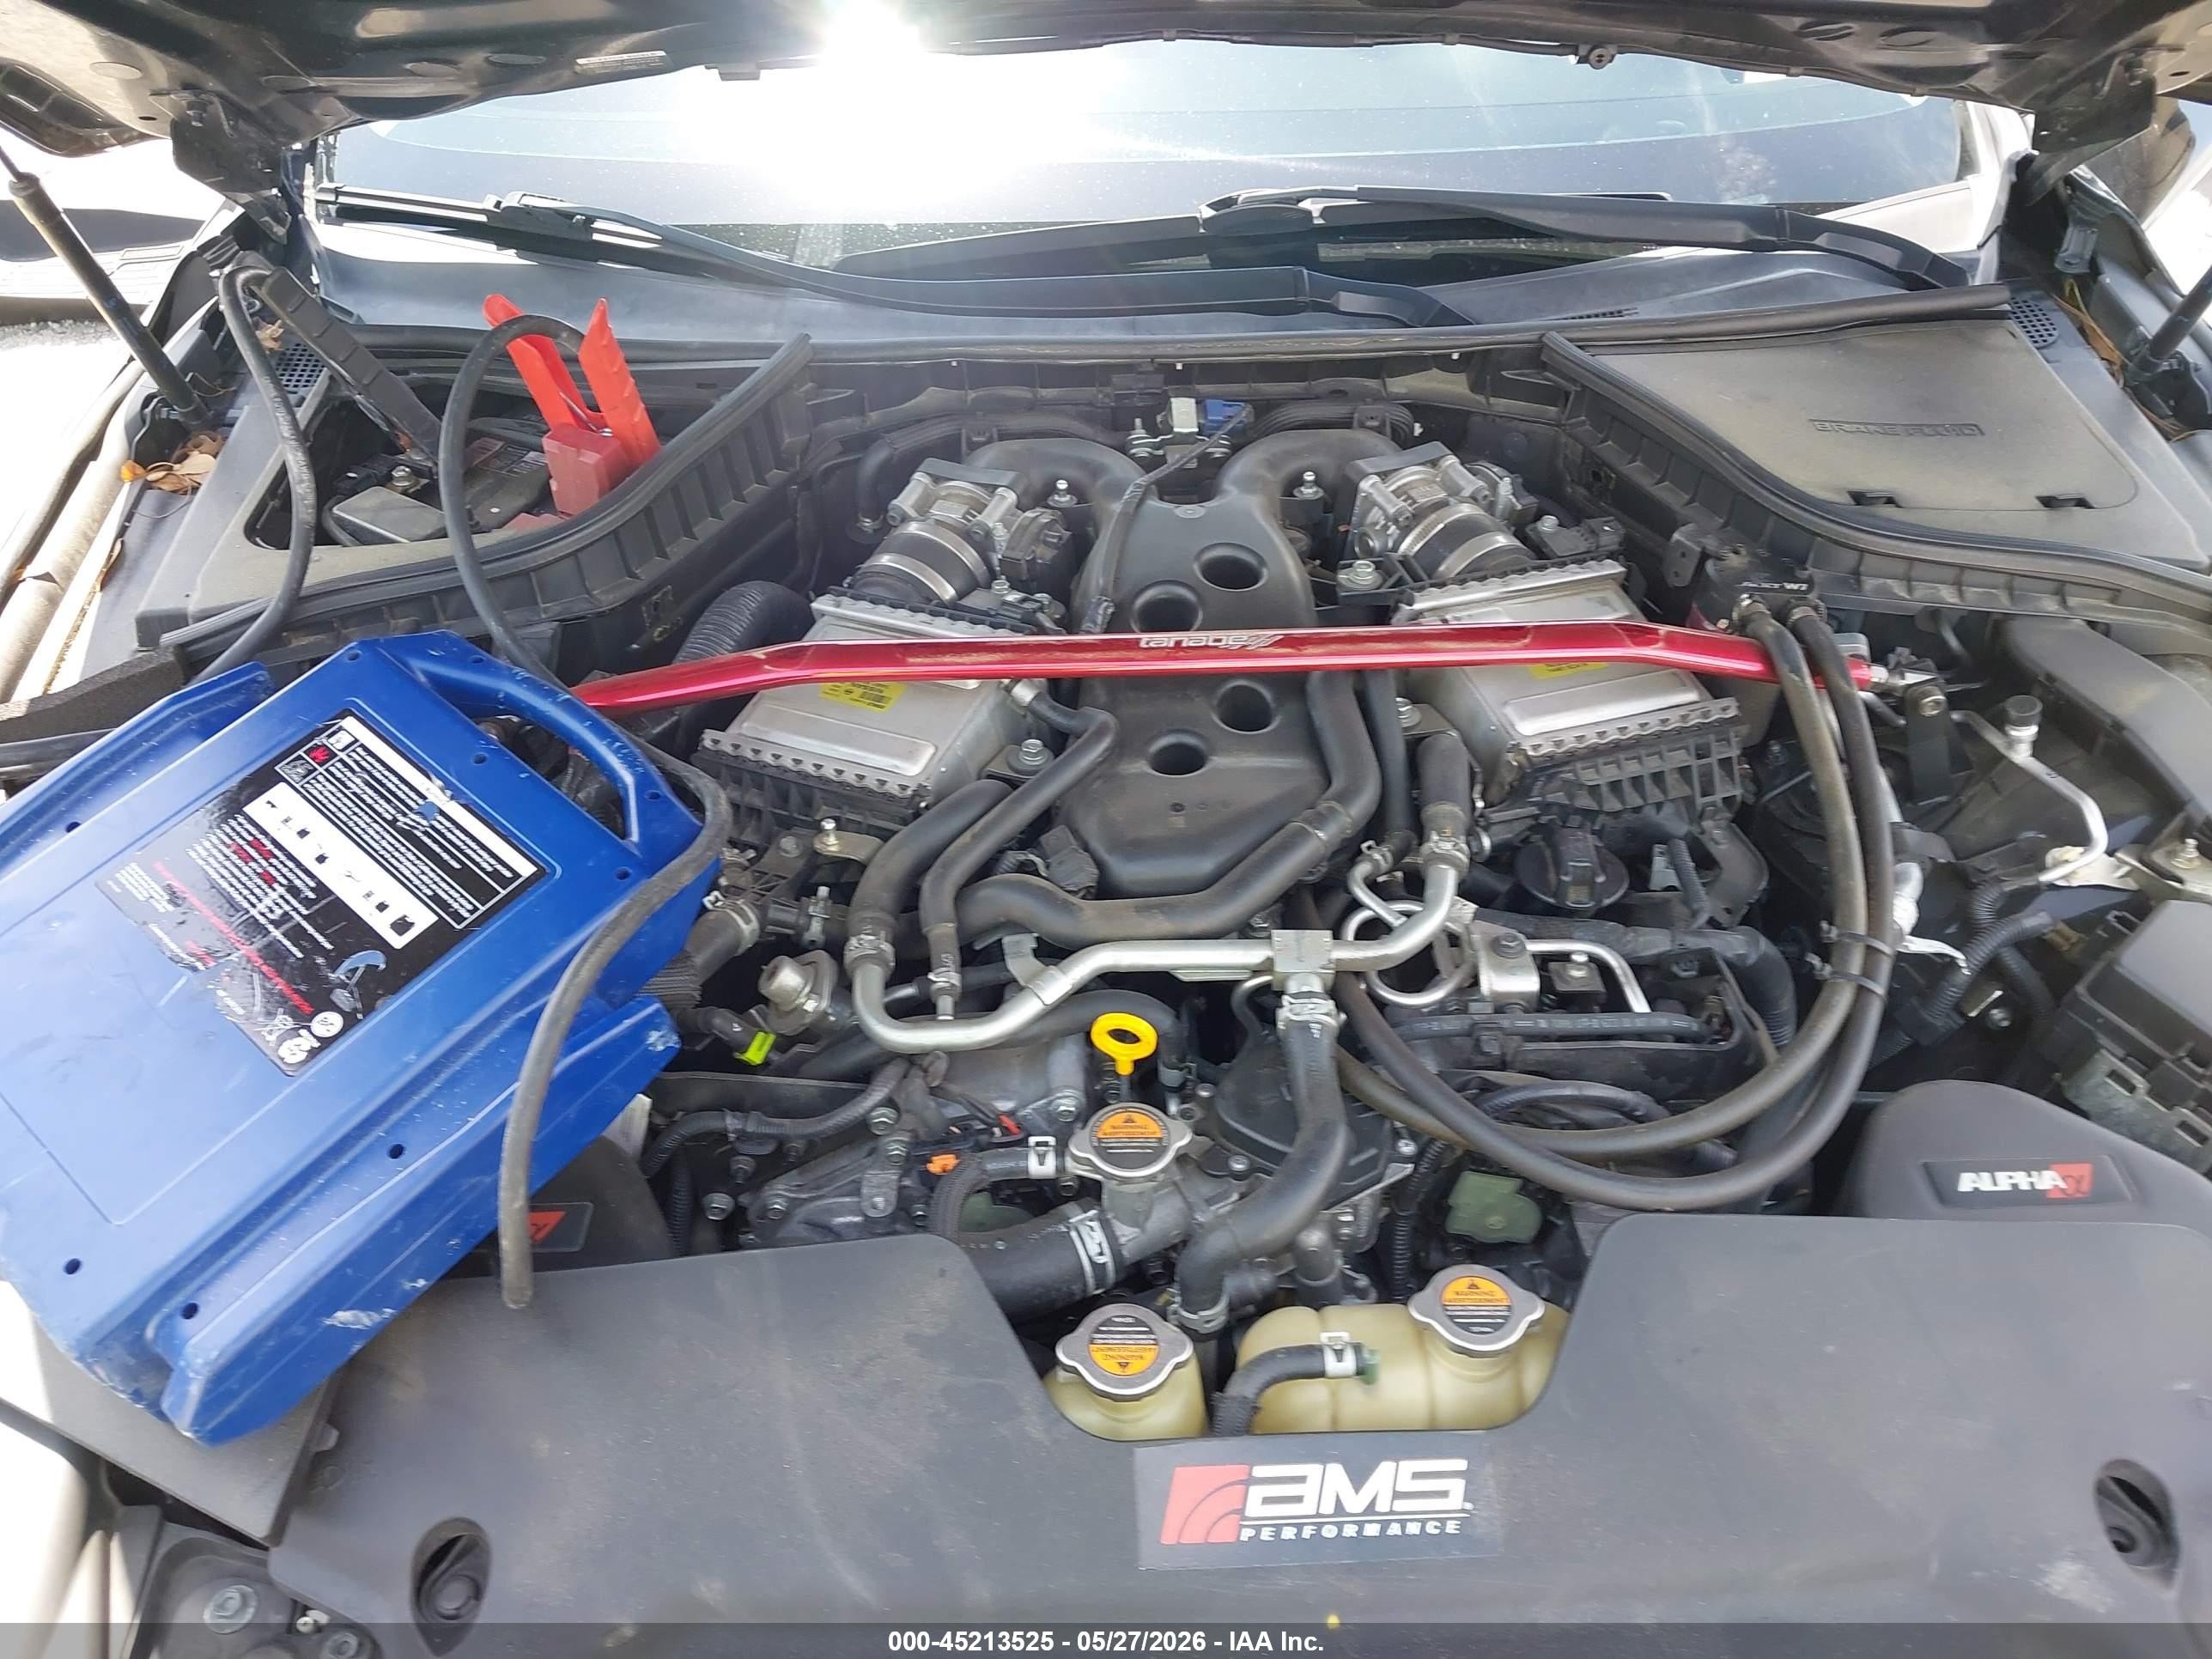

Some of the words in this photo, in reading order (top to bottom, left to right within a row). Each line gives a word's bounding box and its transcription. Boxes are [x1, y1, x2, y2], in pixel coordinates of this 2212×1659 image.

[1813, 421, 1900, 436] BRAKE
[1903, 423, 1981, 437] FLUID
[1139, 635, 1249, 648] tanabe
[1957, 1170, 2069, 1192] ALPHA
[1239, 1521, 1462, 1542] PERFORMANCE
